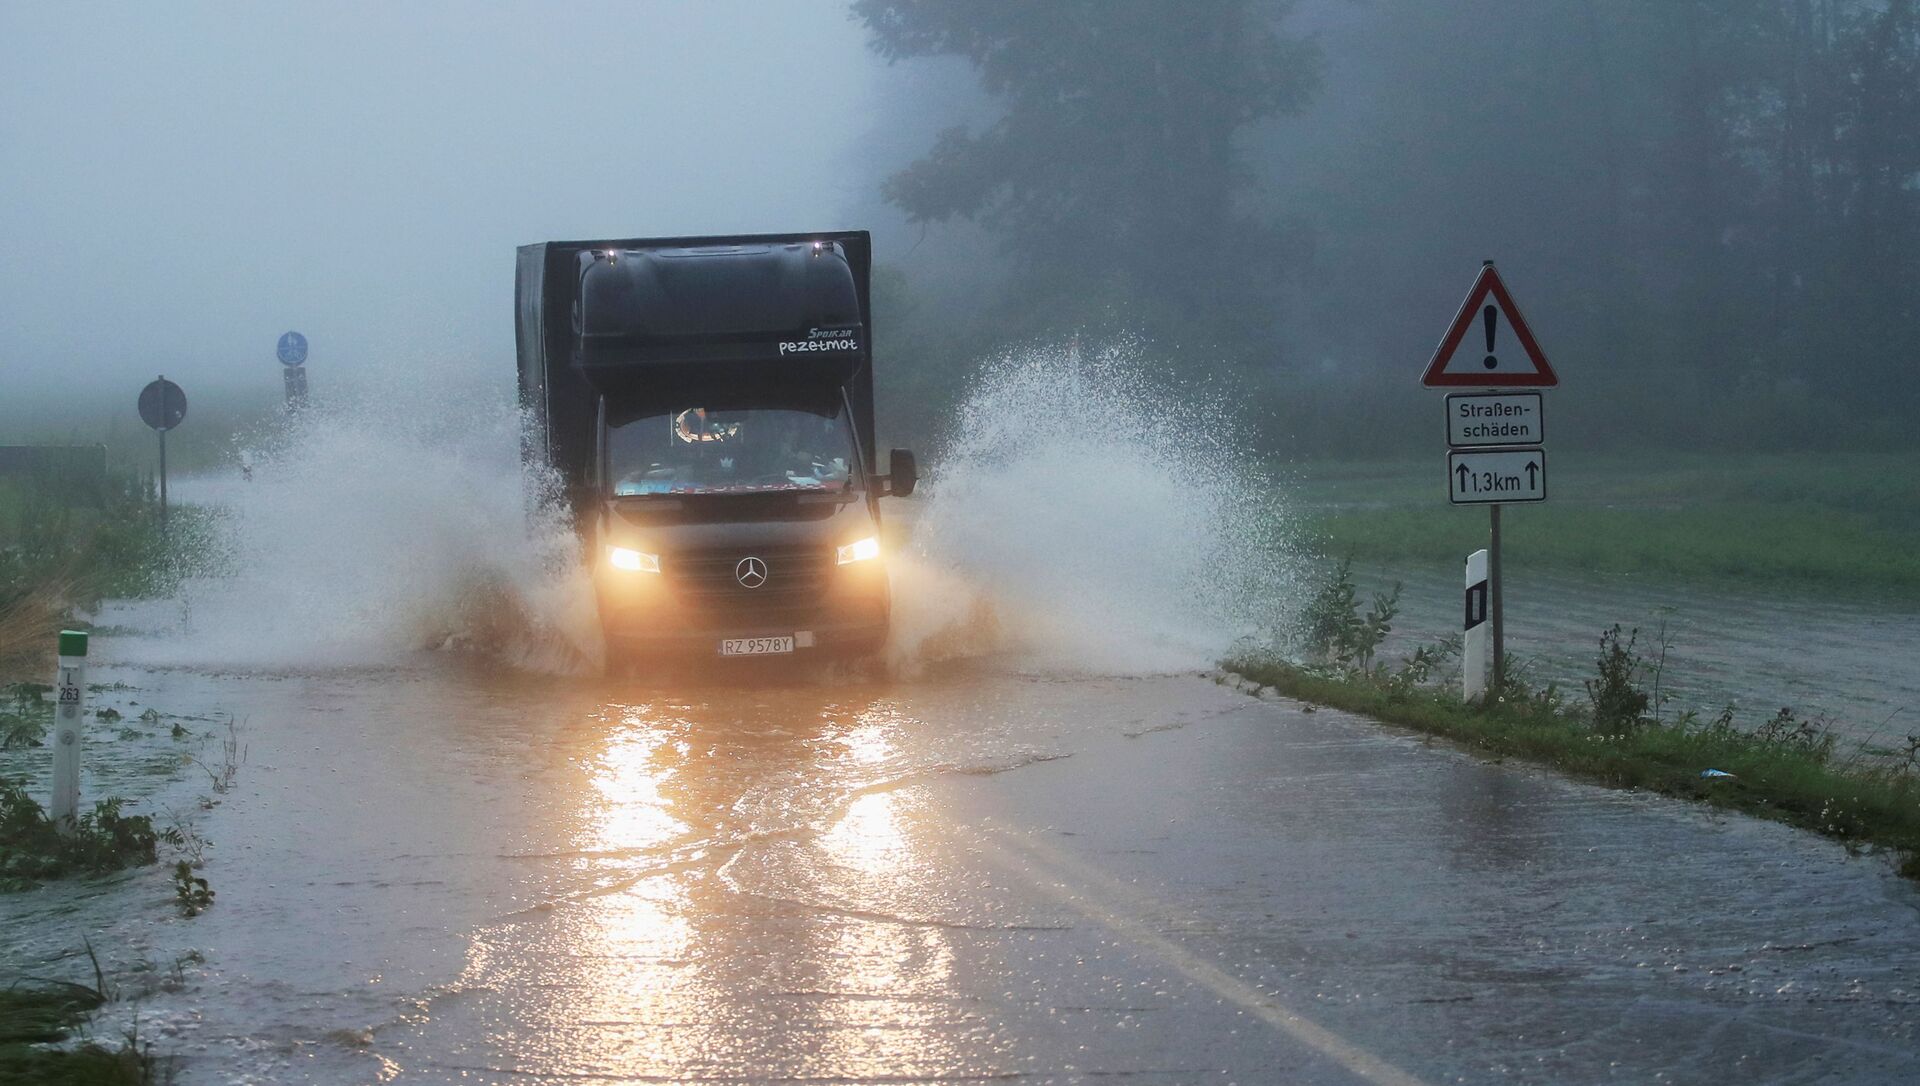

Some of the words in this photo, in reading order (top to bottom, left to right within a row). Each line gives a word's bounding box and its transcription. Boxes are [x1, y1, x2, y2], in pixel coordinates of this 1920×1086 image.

[779, 339, 858, 356] pezetmot
[1460, 403, 1531, 418] Straßen-
[1463, 422, 1529, 437] schäden
[725, 640, 743, 654] RZ
[748, 638, 789, 653] 9578Y
[66, 672, 73, 686] L
[60, 687, 79, 701] 263
